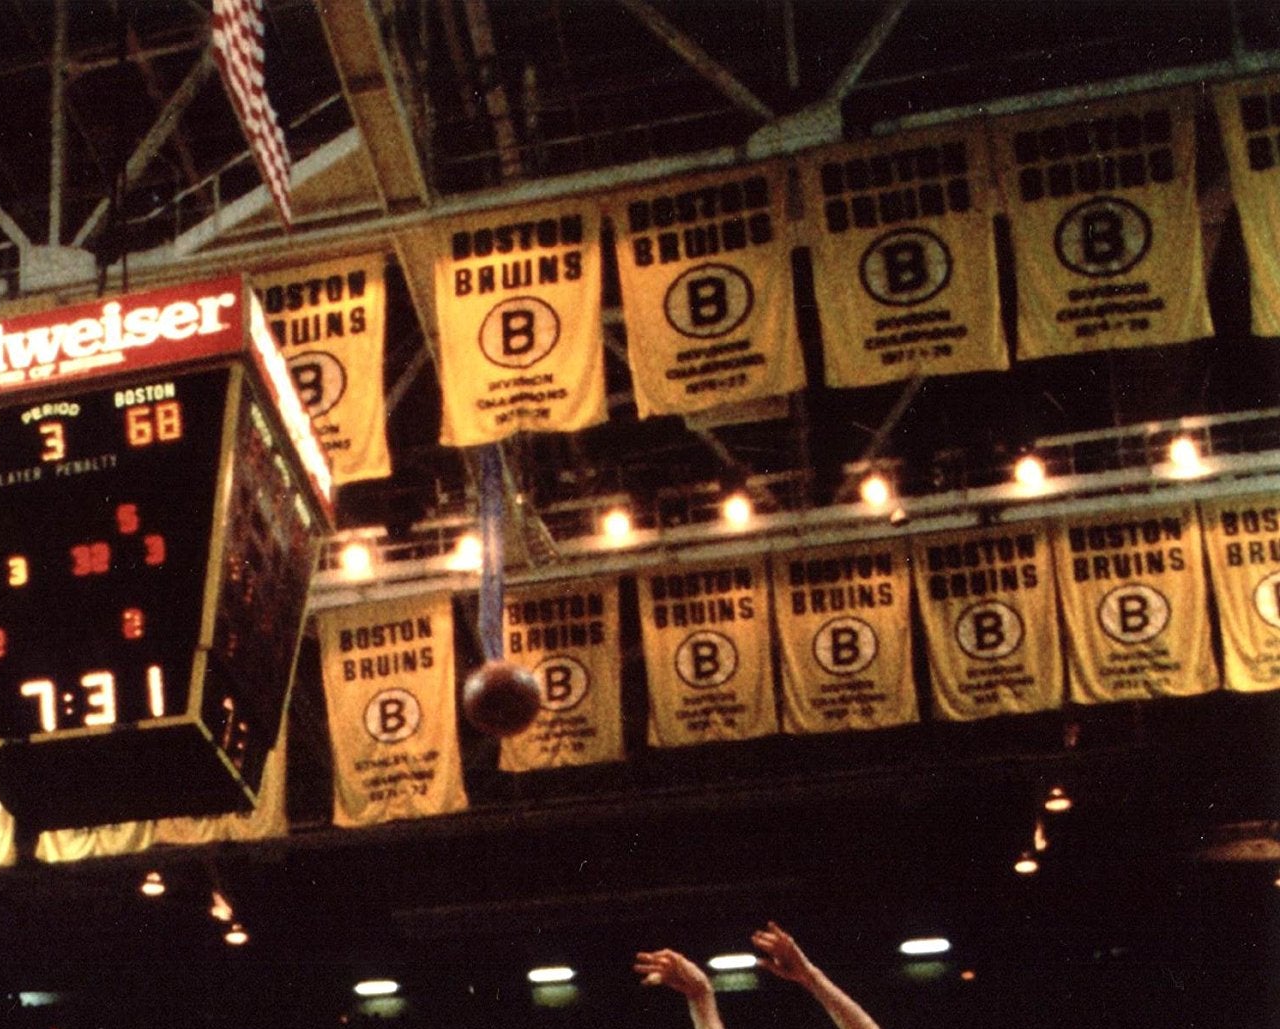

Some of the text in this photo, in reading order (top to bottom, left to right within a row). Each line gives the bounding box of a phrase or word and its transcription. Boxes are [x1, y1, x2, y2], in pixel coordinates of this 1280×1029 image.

[452, 215, 583, 260] BOSTON
[258, 270, 366, 314] OSTON
[455, 252, 582, 297] BRUINS
[687, 277, 728, 327] B
[502, 310, 534, 355] B
[21, 402, 81, 425] PERIOD
[114, 383, 176, 408] BOSTON
[38, 422, 66, 462] 3
[126, 401, 183, 446] 68
[1071, 517, 1182, 552] BOSTON
[7, 555, 28, 586] 3
[929, 564, 1038, 600] BRUINS
[1073, 548, 1185, 583] BRUINS
[654, 596, 754, 629] BRUINS
[792, 582, 893, 615] BRUINS
[1120, 594, 1149, 633] B
[340, 616, 433, 653] BOSTON
[510, 621, 605, 653] BRUINS
[832, 627, 859, 666] B
[973, 610, 1005, 651] B
[343, 647, 434, 682] BRUINS
[692, 640, 718, 680] B
[545, 665, 572, 702] B
[379, 699, 406, 734] B
